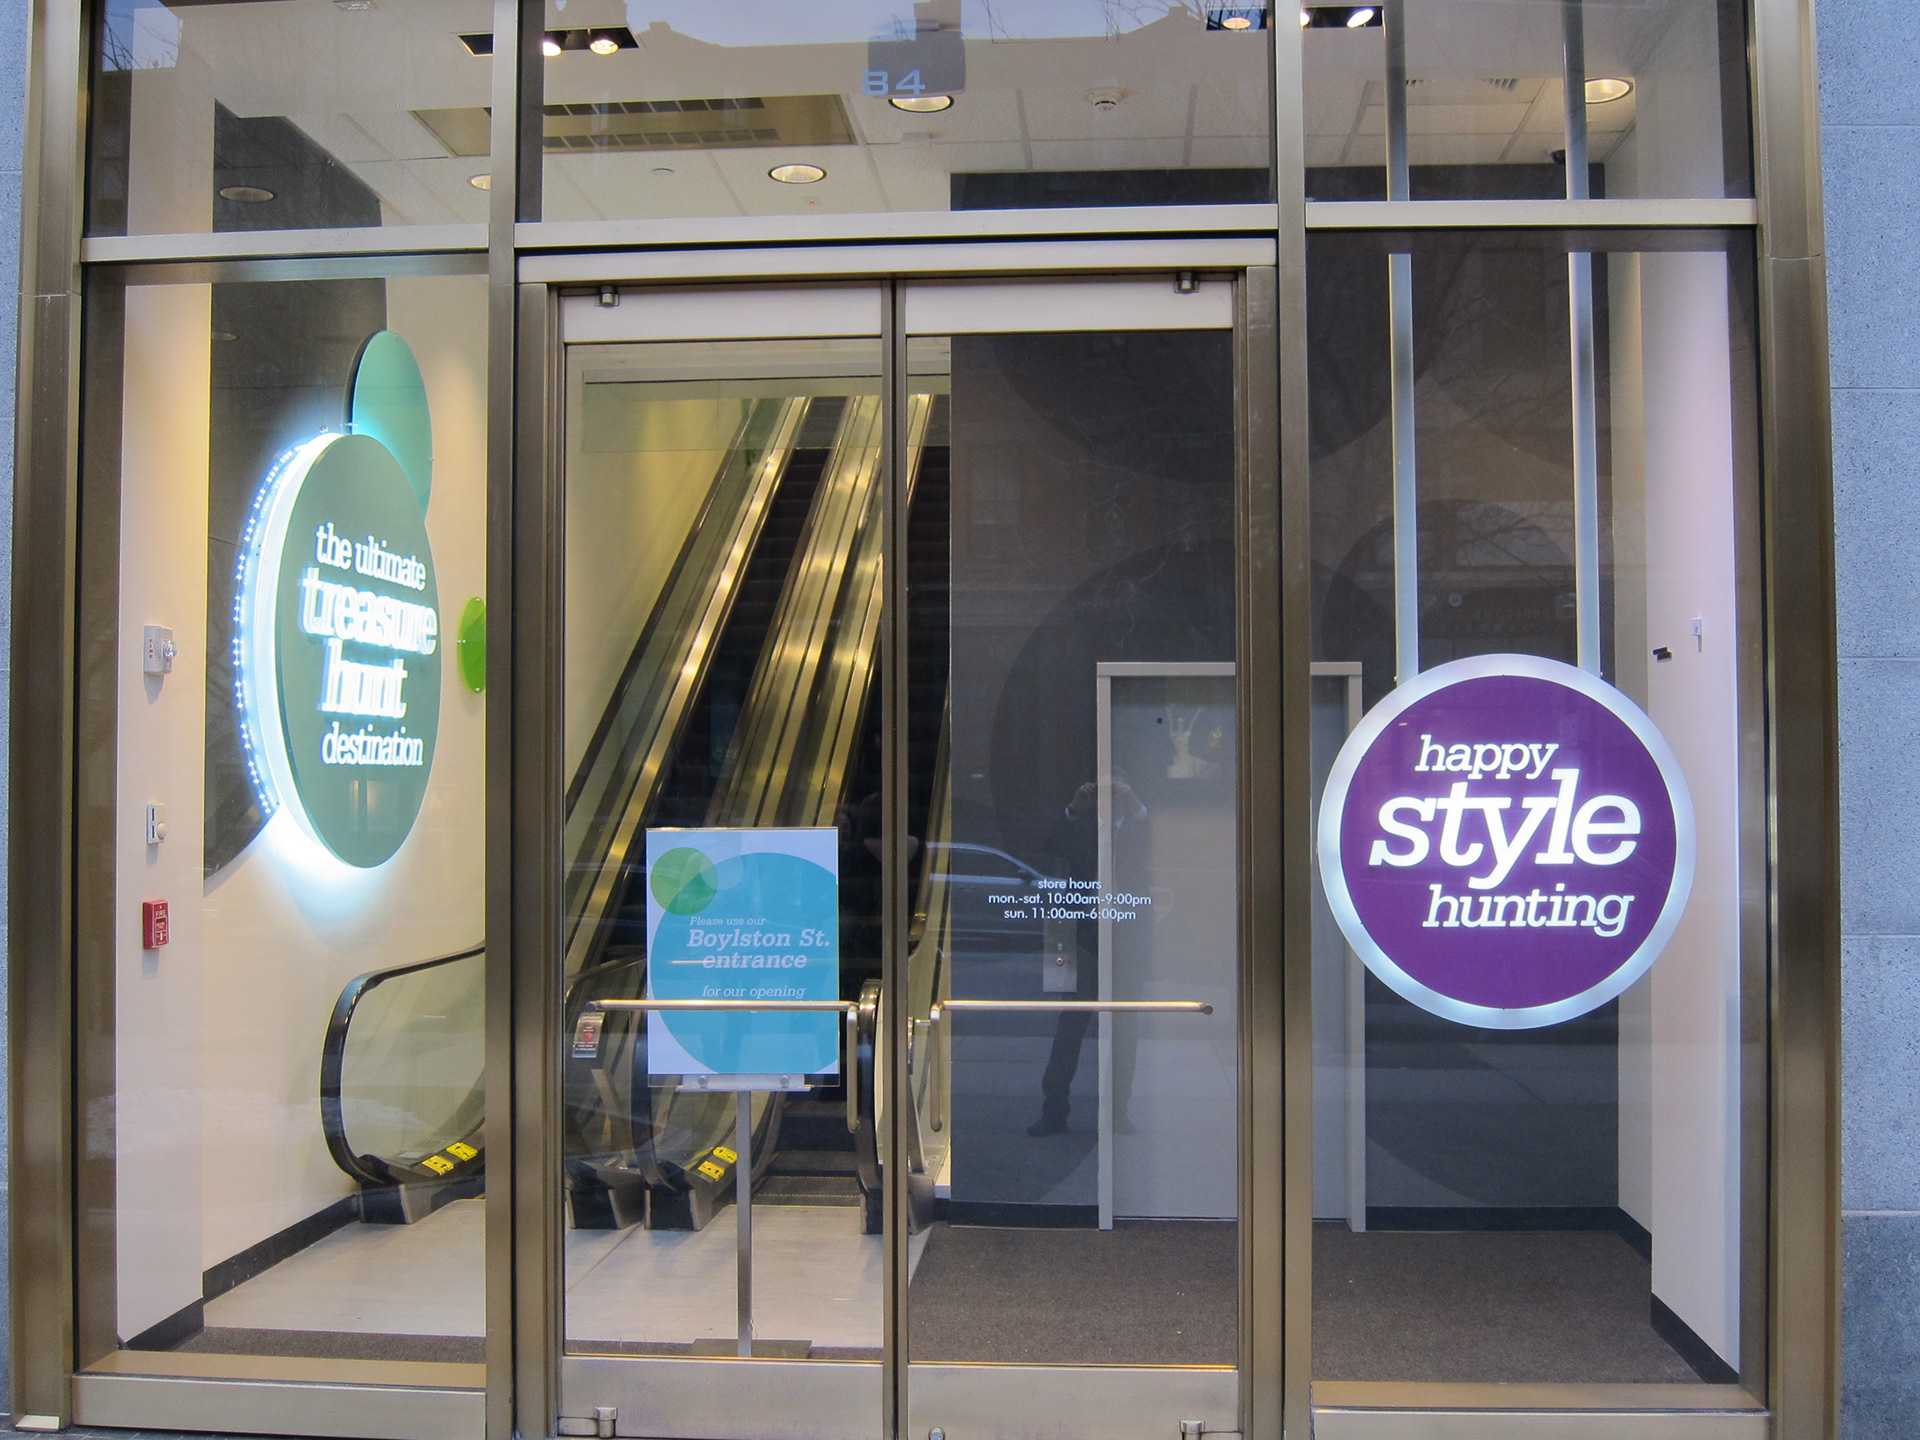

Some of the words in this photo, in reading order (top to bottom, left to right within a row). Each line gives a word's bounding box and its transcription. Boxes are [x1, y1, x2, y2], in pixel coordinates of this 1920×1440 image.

[861, 70, 926, 95] 84
[316, 522, 352, 569] the
[354, 535, 426, 591] ultimate
[301, 567, 438, 655] treasure
[320, 637, 408, 719] hunt
[322, 721, 424, 766] destination
[1414, 734, 1559, 780] happy
[1368, 768, 1642, 890] style
[1037, 878, 1067, 889] store
[1068, 877, 1102, 889] hours
[988, 893, 1044, 904] mon.-sat.
[1047, 892, 1152, 907] 10:00am-9:00pm
[1422, 883, 1635, 937] hunting
[690, 916, 724, 926] Please
[726, 917, 744, 926] use
[746, 917, 766, 926] our
[1003, 909, 1029, 919] sun.
[1031, 907, 1137, 922] 11:00am-6:00pm
[687, 929, 791, 951] Boylston
[799, 928, 831, 947] St.
[702, 952, 808, 969] entrance
[701, 985, 721, 998] for
[723, 987, 746, 998] our
[749, 985, 806, 999] opening
